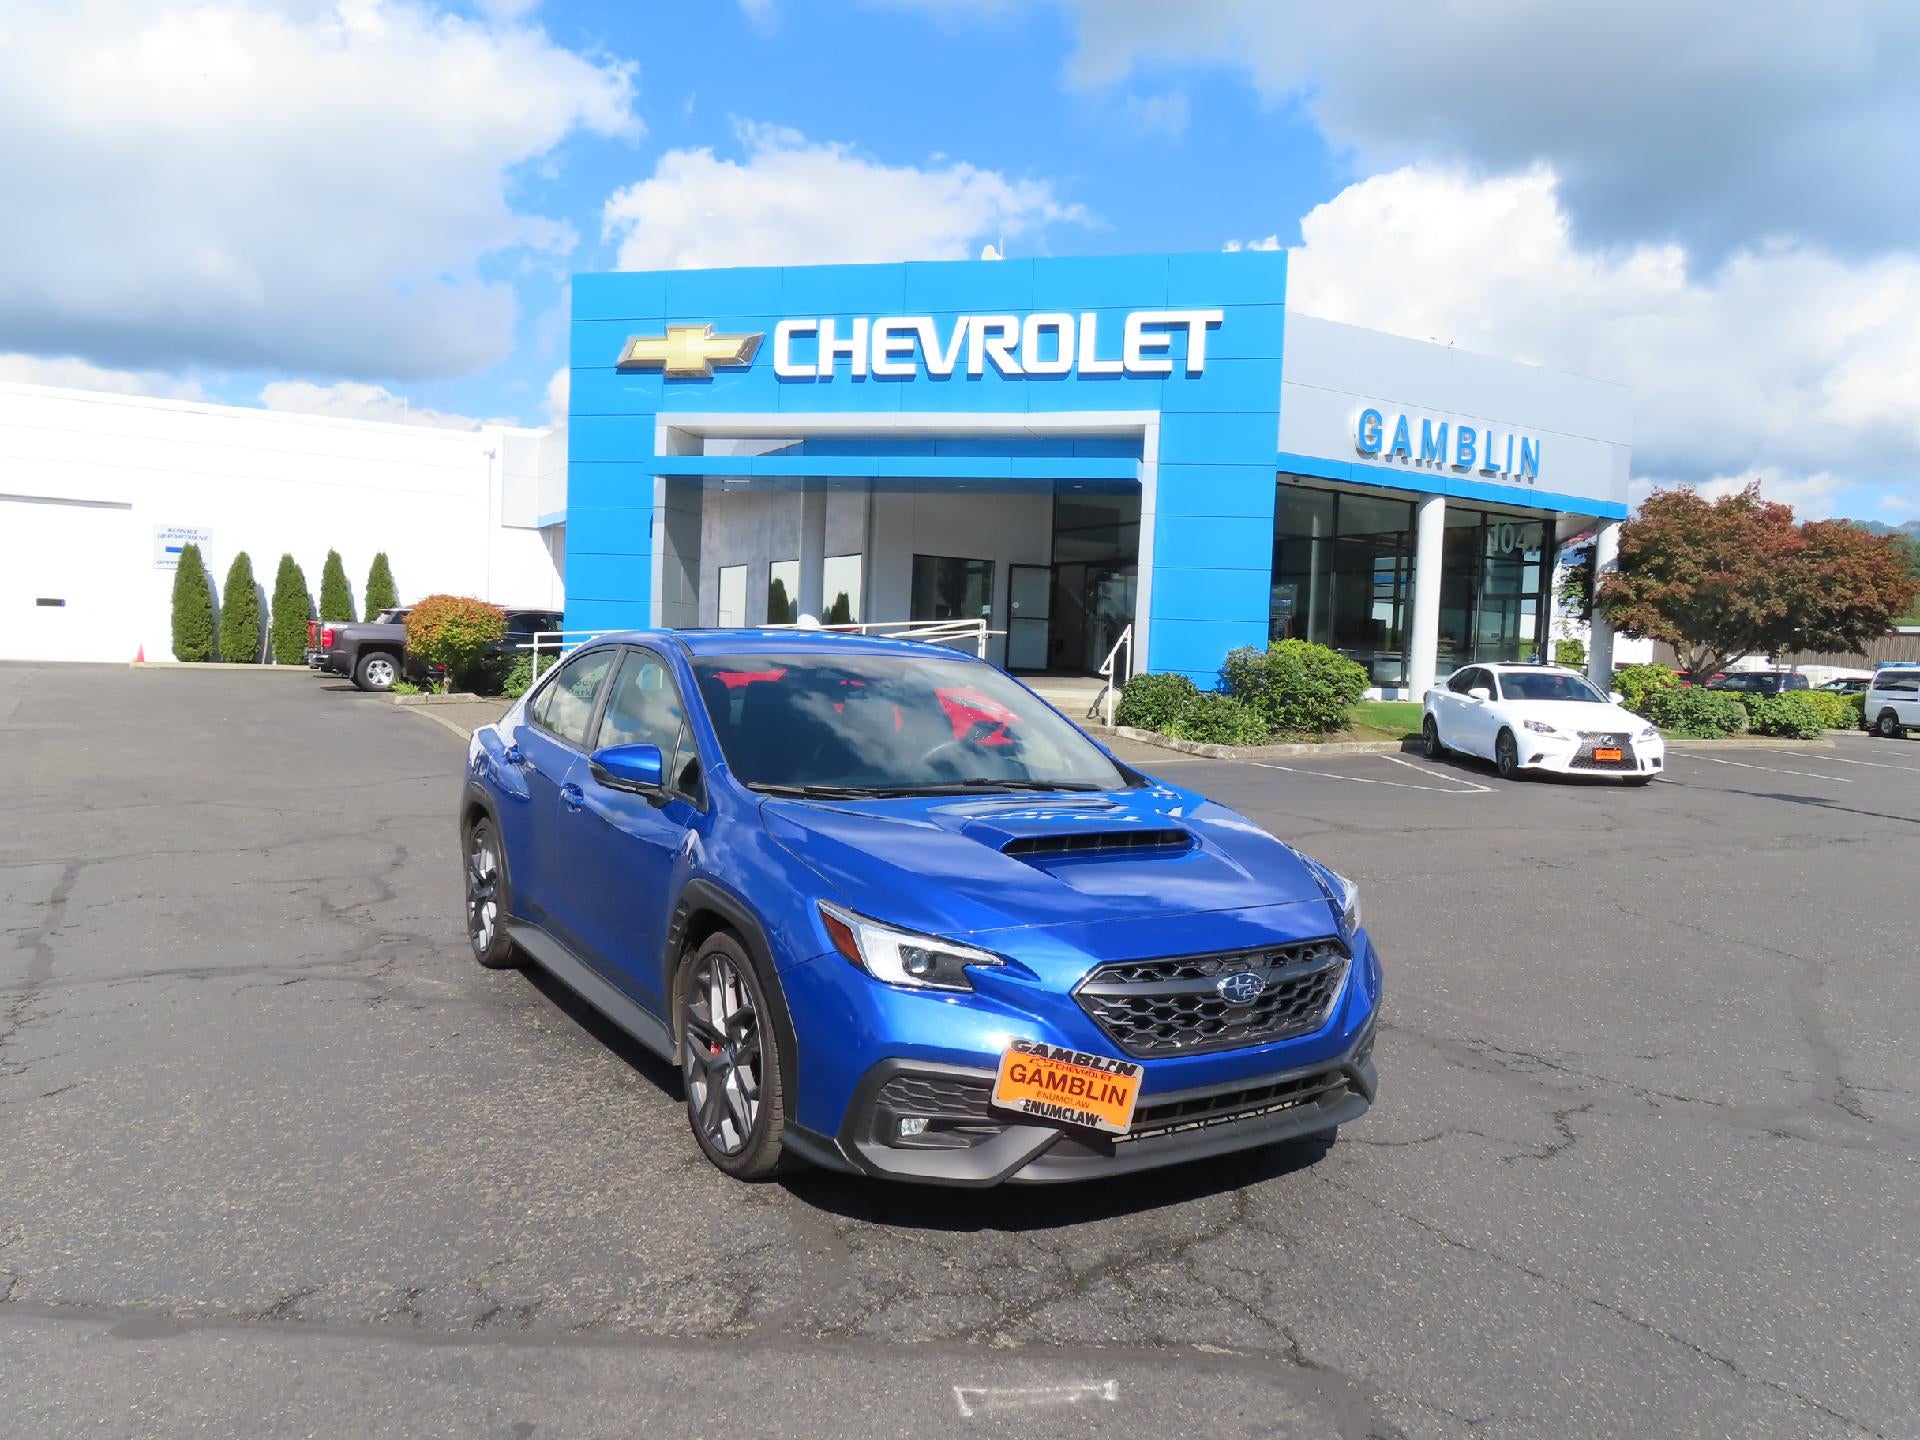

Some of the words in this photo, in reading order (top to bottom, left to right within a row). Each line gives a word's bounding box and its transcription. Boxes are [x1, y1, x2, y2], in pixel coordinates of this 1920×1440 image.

[774, 310, 1224, 379] CHEVROLET
[1356, 407, 1541, 479] GAMBLIN
[1010, 1039, 1138, 1077] GAMBLIN
[1055, 1064, 1113, 1083] CHEVROLET
[1009, 1063, 1128, 1108] GAMBLIN
[1036, 1090, 1090, 1110] ENUMCLAW
[1022, 1099, 1099, 1127] ENUMCLAW
